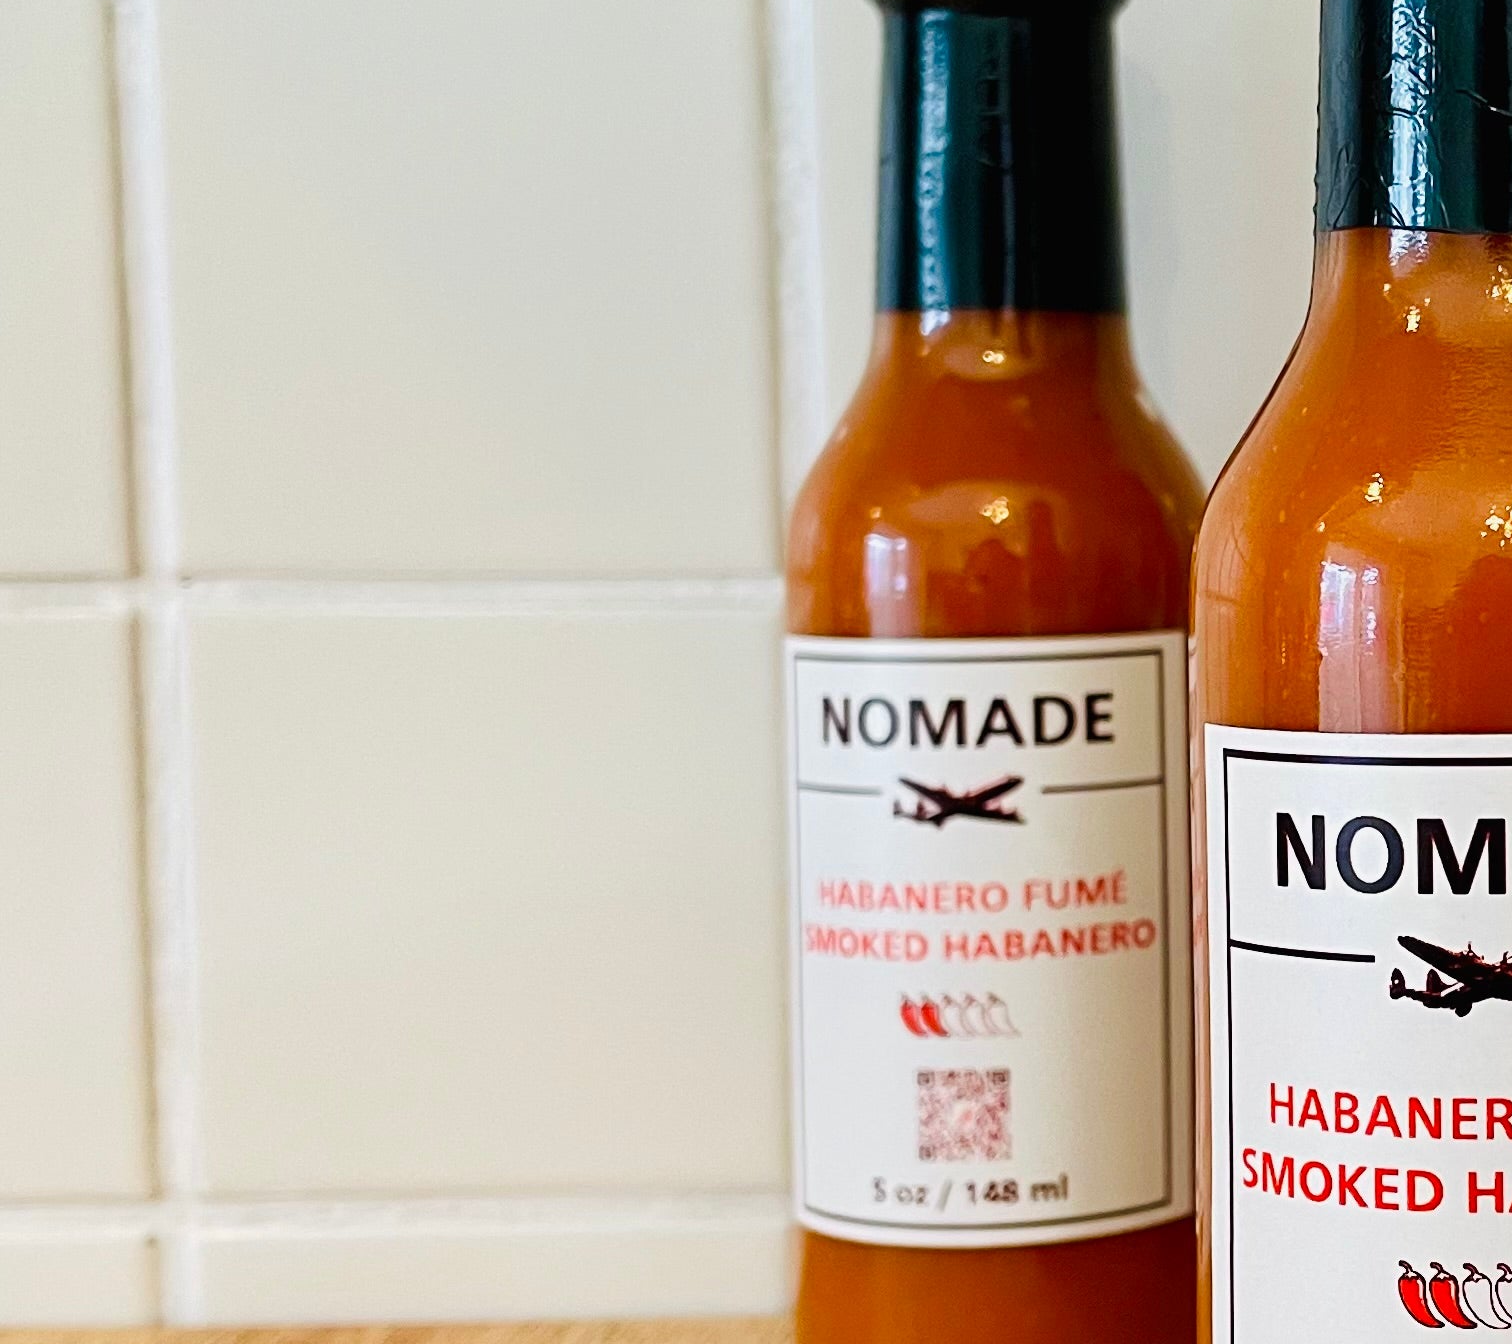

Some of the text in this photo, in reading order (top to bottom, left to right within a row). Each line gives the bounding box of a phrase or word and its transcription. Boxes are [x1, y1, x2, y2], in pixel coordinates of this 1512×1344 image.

[823, 691, 1116, 747] NOMADE
[821, 869, 1128, 913] HABANERO FUMÉ
[805, 919, 1157, 962] SMOKED HABANERO
[873, 1177, 887, 1202] 5
[896, 1186, 929, 1205] oz
[967, 1180, 1019, 1203] 148
[1030, 1173, 1069, 1201] ml
[1243, 1148, 1444, 1212] SMOKED
